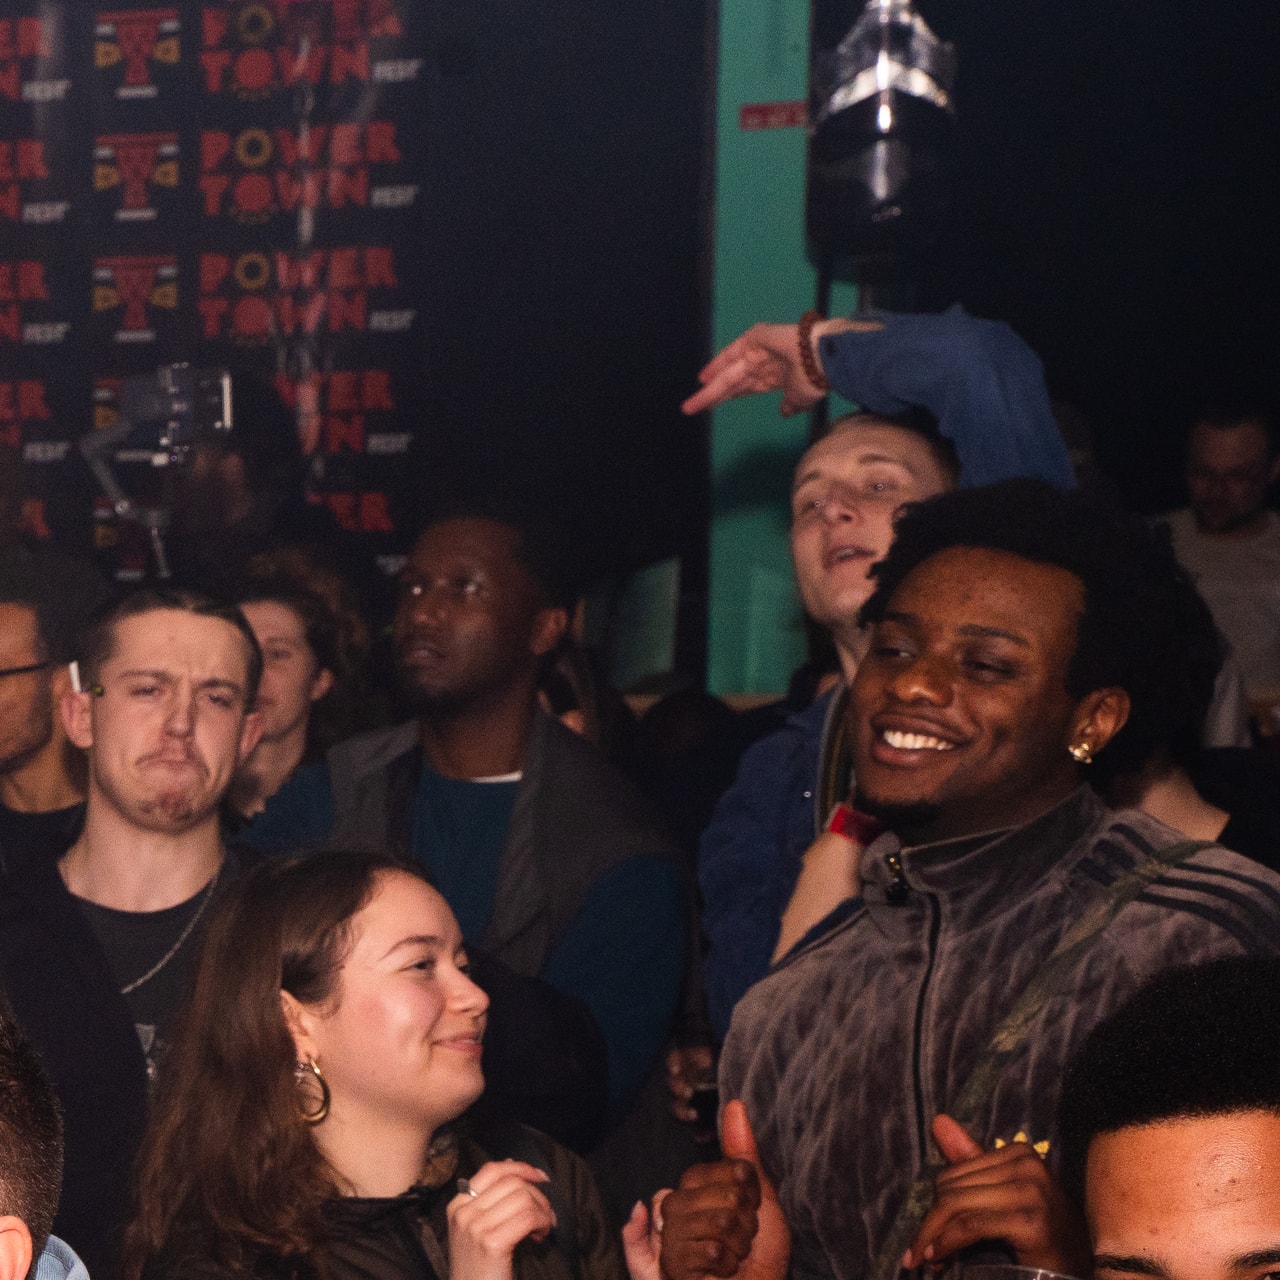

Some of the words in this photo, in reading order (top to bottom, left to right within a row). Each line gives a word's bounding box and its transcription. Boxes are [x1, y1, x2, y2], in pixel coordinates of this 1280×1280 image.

[200, 42, 369, 92] TOWN
[201, 121, 400, 170] POWER
[200, 168, 368, 216] TOWN
[200, 247, 397, 293] POWER
[198, 291, 367, 338] TOWN
[273, 369, 396, 411] WER
